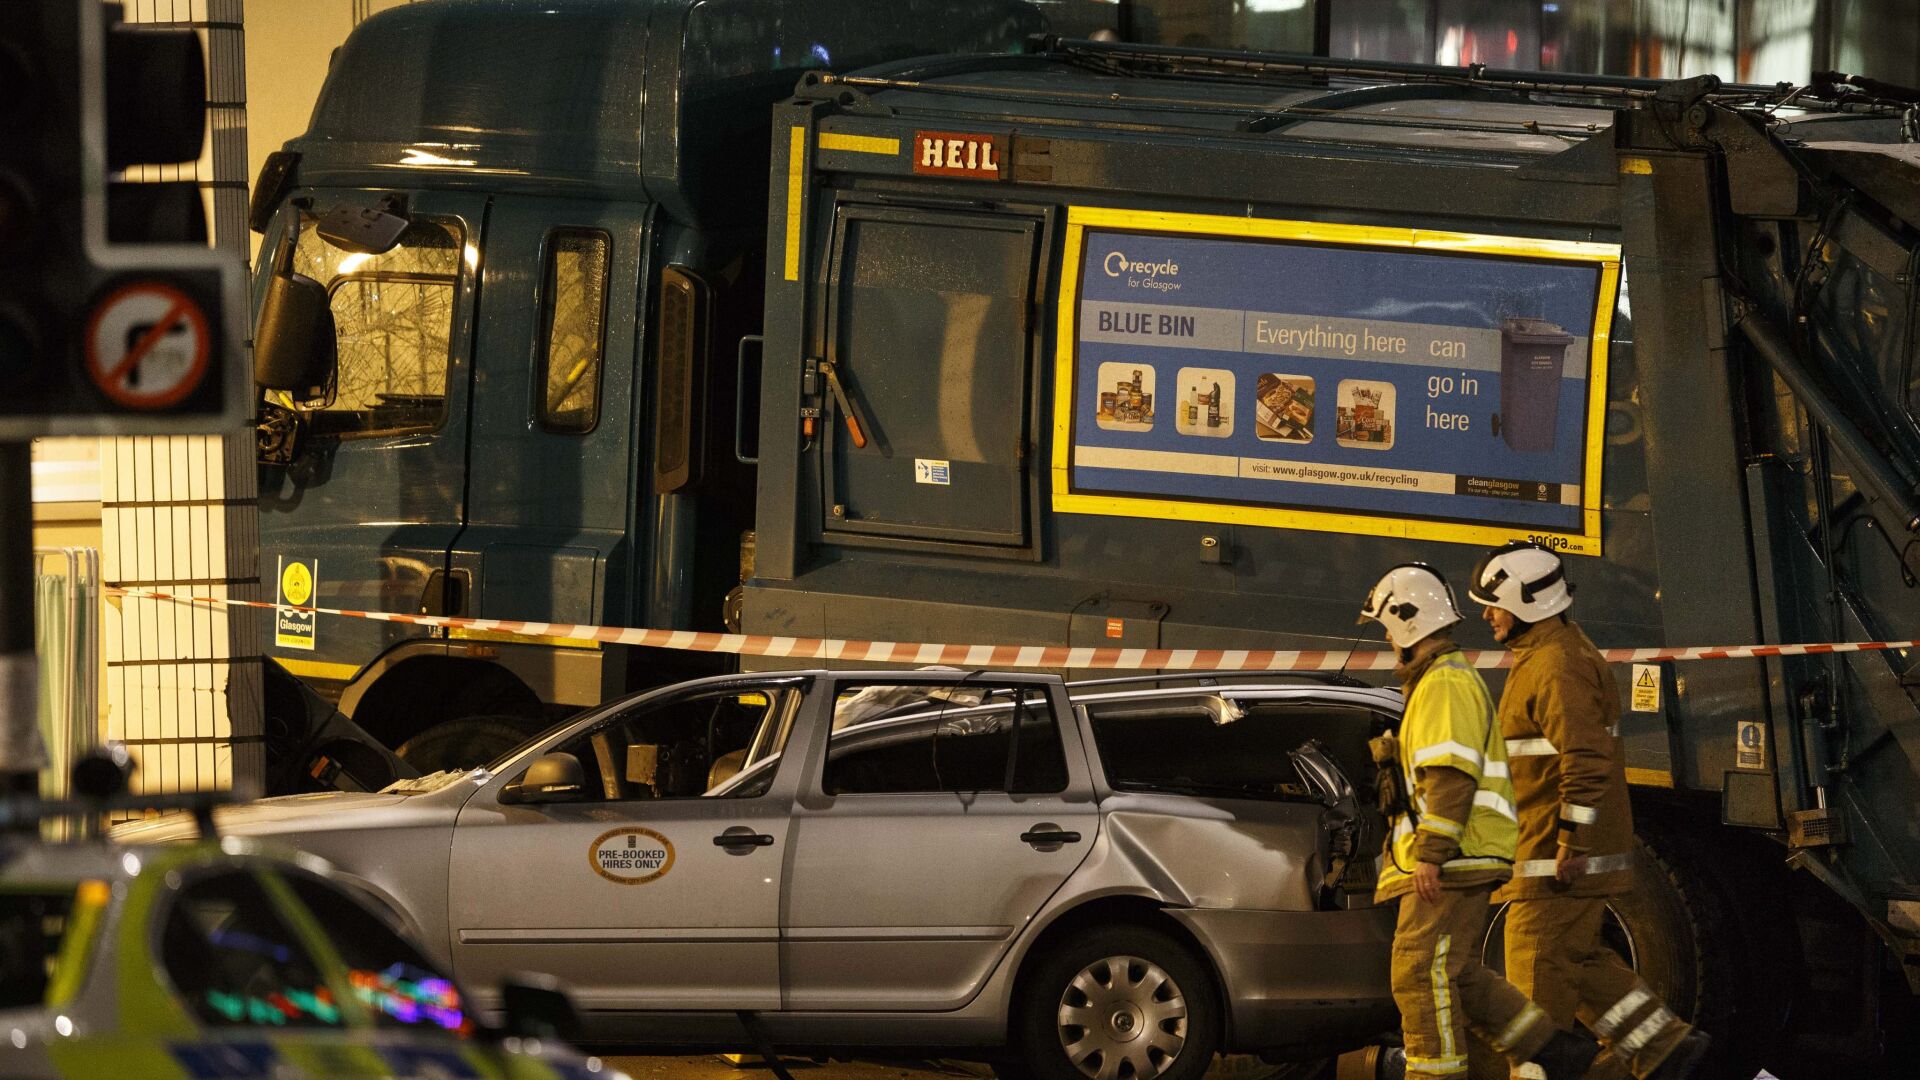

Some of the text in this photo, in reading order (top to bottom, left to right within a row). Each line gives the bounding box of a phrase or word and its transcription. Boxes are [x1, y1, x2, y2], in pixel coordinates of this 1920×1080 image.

[921, 138, 998, 171] HEIL
[1129, 259, 1179, 277] recycle
[1127, 276, 1181, 292] for Glasgow
[1098, 310, 1195, 338] BLUE BIN
[1256, 320, 1466, 359] Everything here can
[1427, 372, 1479, 398] go in
[1425, 404, 1470, 431] here
[1252, 462, 1419, 487] visit: www.glasgow.gov.uk/recycling
[1467, 477, 1520, 490] cleanglasgow
[280, 618, 313, 634] Glasgow
[598, 849, 666, 860] PRE-BOOKED
[602, 859, 662, 869] HIRES ONLY
